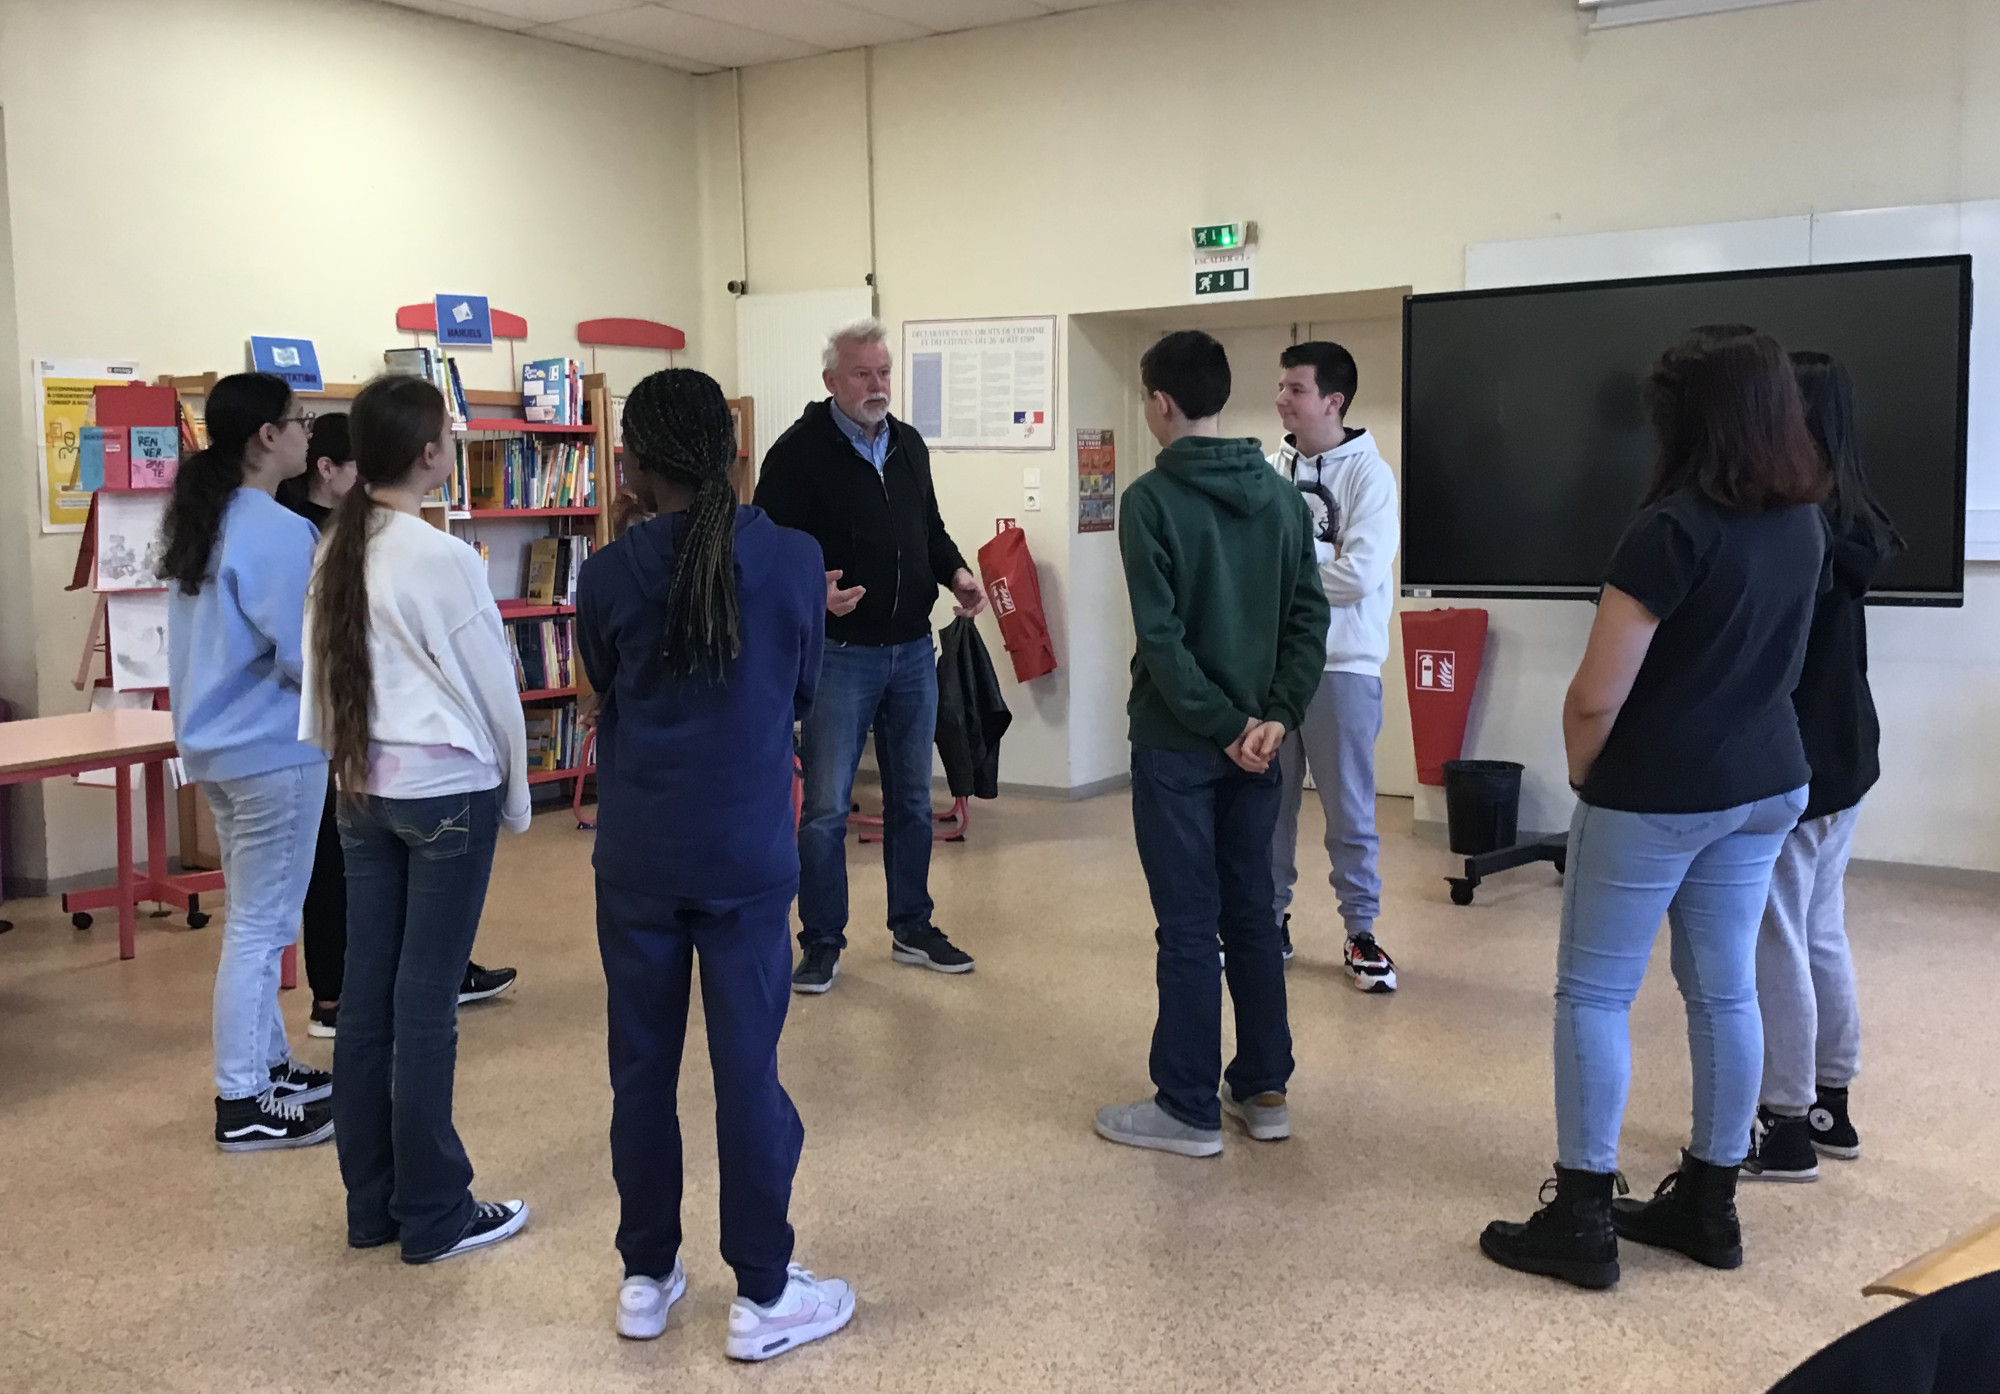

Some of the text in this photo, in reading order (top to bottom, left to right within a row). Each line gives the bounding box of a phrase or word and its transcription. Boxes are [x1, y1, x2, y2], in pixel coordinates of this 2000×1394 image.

[446, 328, 482, 338] MANUELS
[137, 435, 158, 447] REN
[143, 447, 162, 458] VER
[152, 468, 165, 478] TE
